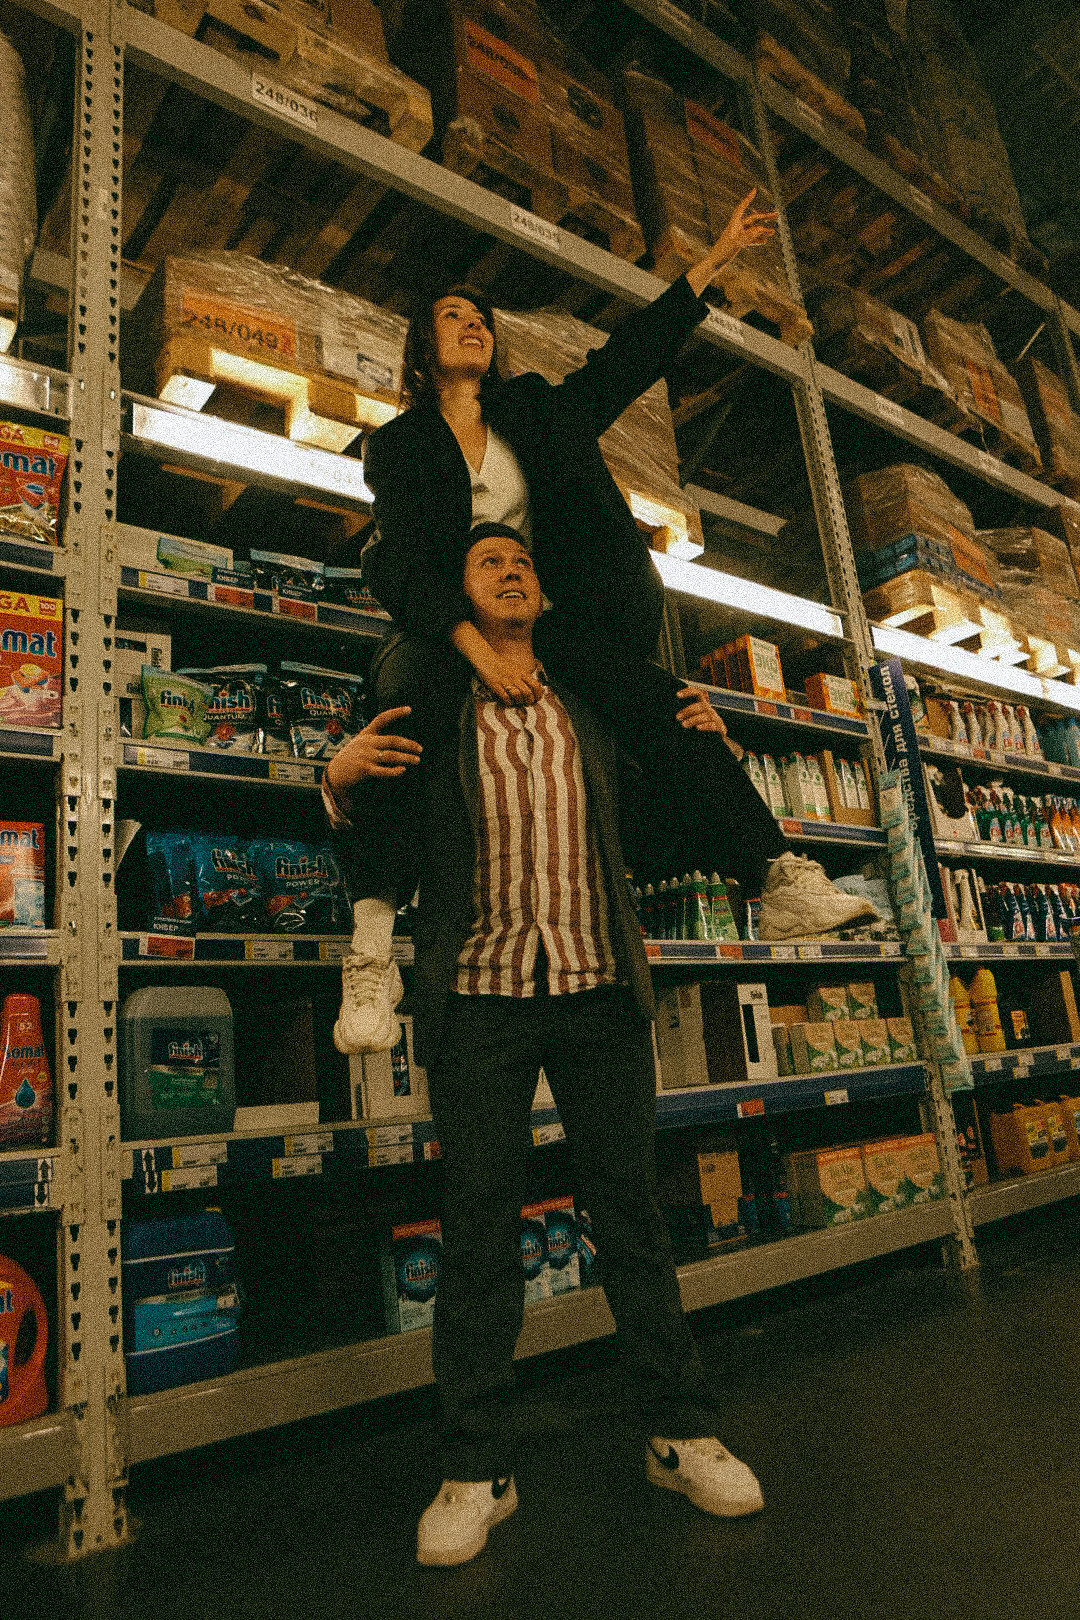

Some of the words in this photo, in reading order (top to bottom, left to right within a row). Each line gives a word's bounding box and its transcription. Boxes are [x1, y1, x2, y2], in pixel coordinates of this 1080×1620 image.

[880, 665, 900, 720] стекол
[892, 723, 908, 753] для
[286, 879, 320, 888] POWER
